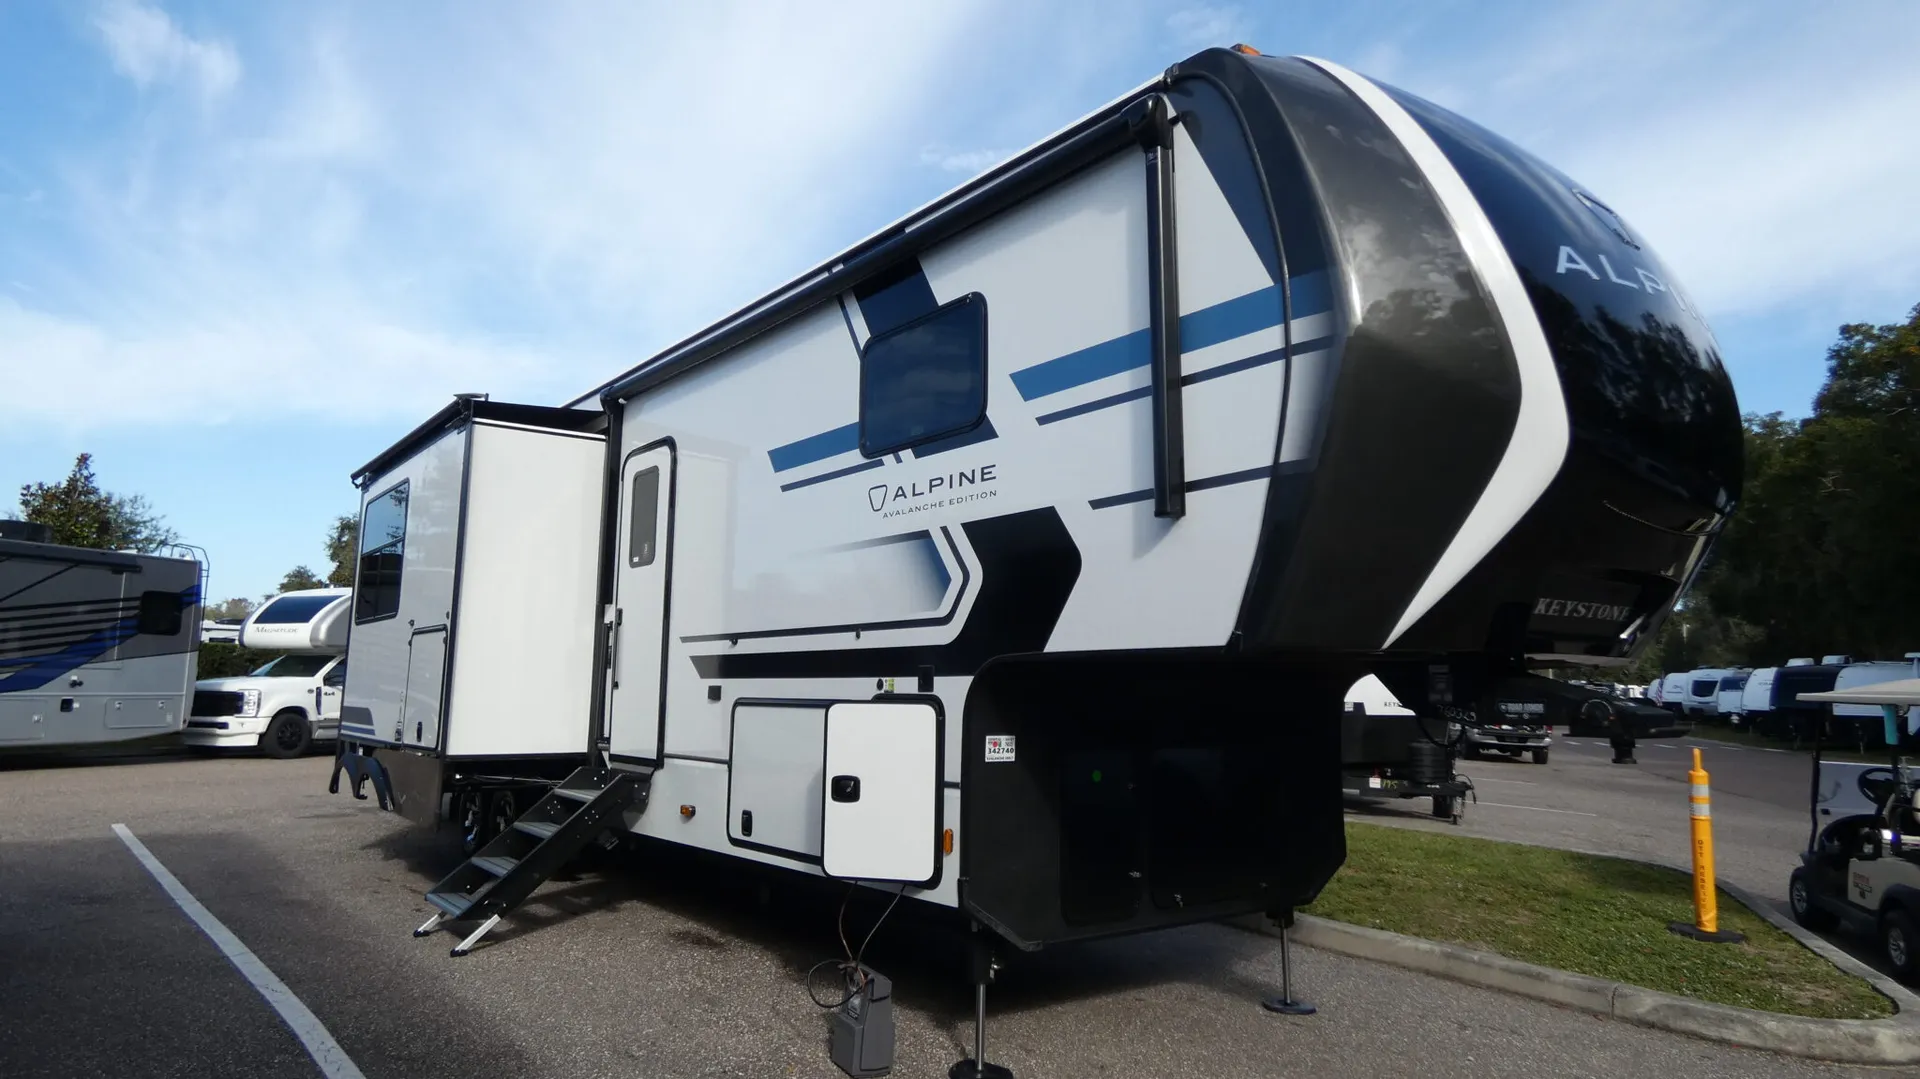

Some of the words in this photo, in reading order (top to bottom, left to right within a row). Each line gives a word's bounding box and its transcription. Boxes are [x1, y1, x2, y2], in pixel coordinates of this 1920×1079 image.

[1556, 245, 1711, 331] ALPI
[892, 464, 997, 502] ALPINE
[882, 500, 945, 519] AVALANCHE
[949, 489, 998, 506] EDITION
[1532, 598, 1630, 621] KEYSTONE
